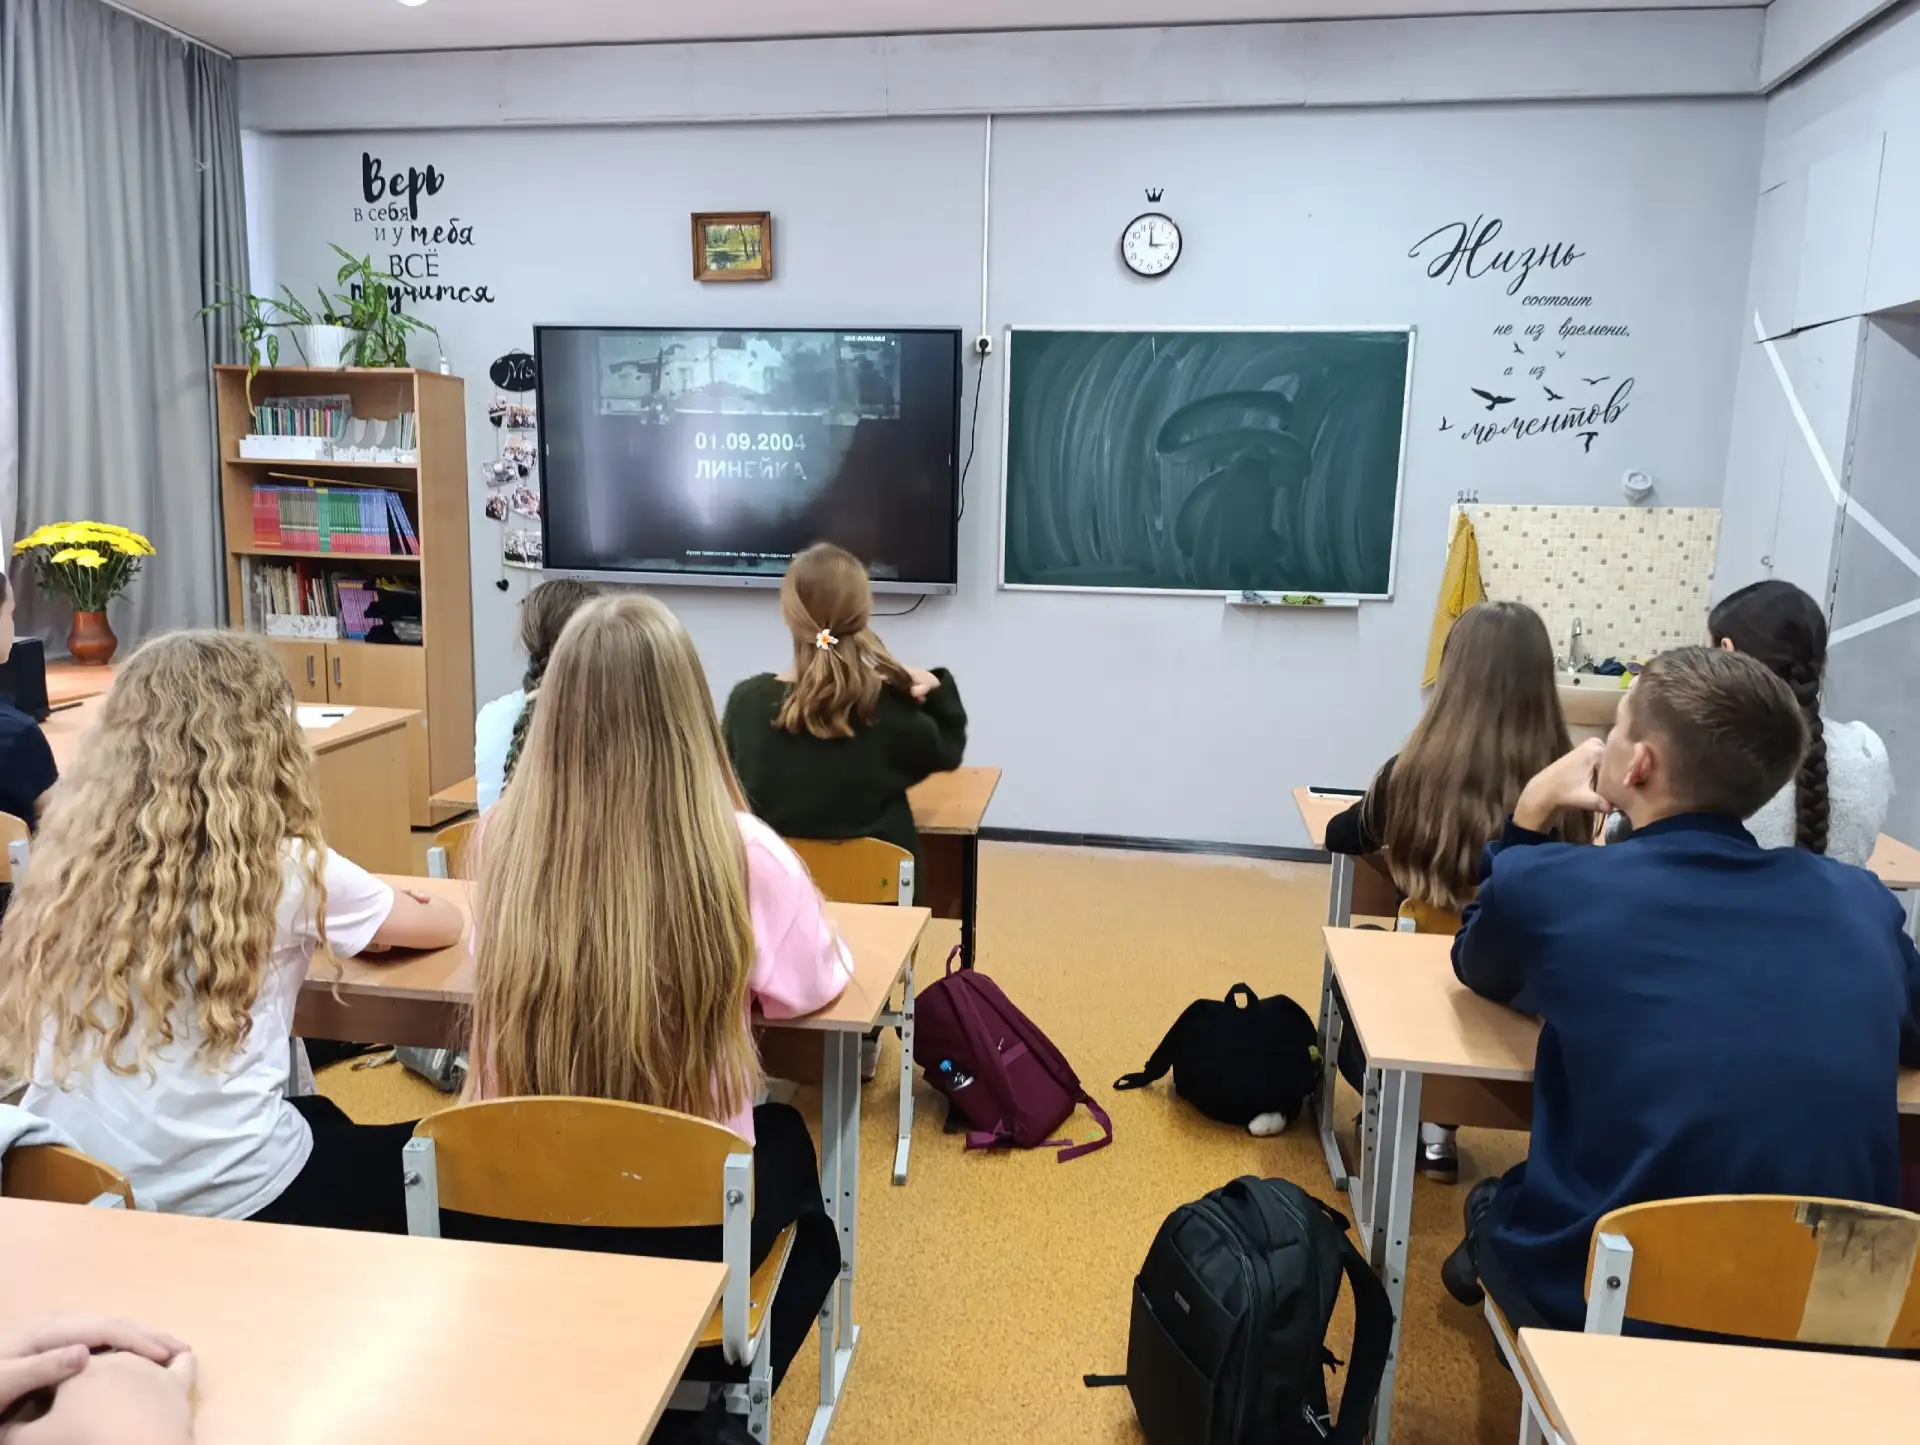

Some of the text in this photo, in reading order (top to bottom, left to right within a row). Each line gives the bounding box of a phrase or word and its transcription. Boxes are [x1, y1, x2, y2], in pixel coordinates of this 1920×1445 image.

[363, 152, 444, 220] Верь
[354, 208, 363, 222] в
[375, 218, 476, 247] и у тебя
[389, 249, 439, 278] ВСЁ
[1408, 214, 1586, 296] Жизнь
[351, 283, 495, 315] пучится
[1522, 295, 1593, 307] состоит
[1493, 324, 1513, 336] не
[1524, 324, 1545, 341] из
[1503, 365, 1546, 380] а из
[1461, 377, 1635, 445] моментов
[694, 432, 806, 451] 01.09.2004
[694, 456, 807, 480] ЛИНЕЙКА
